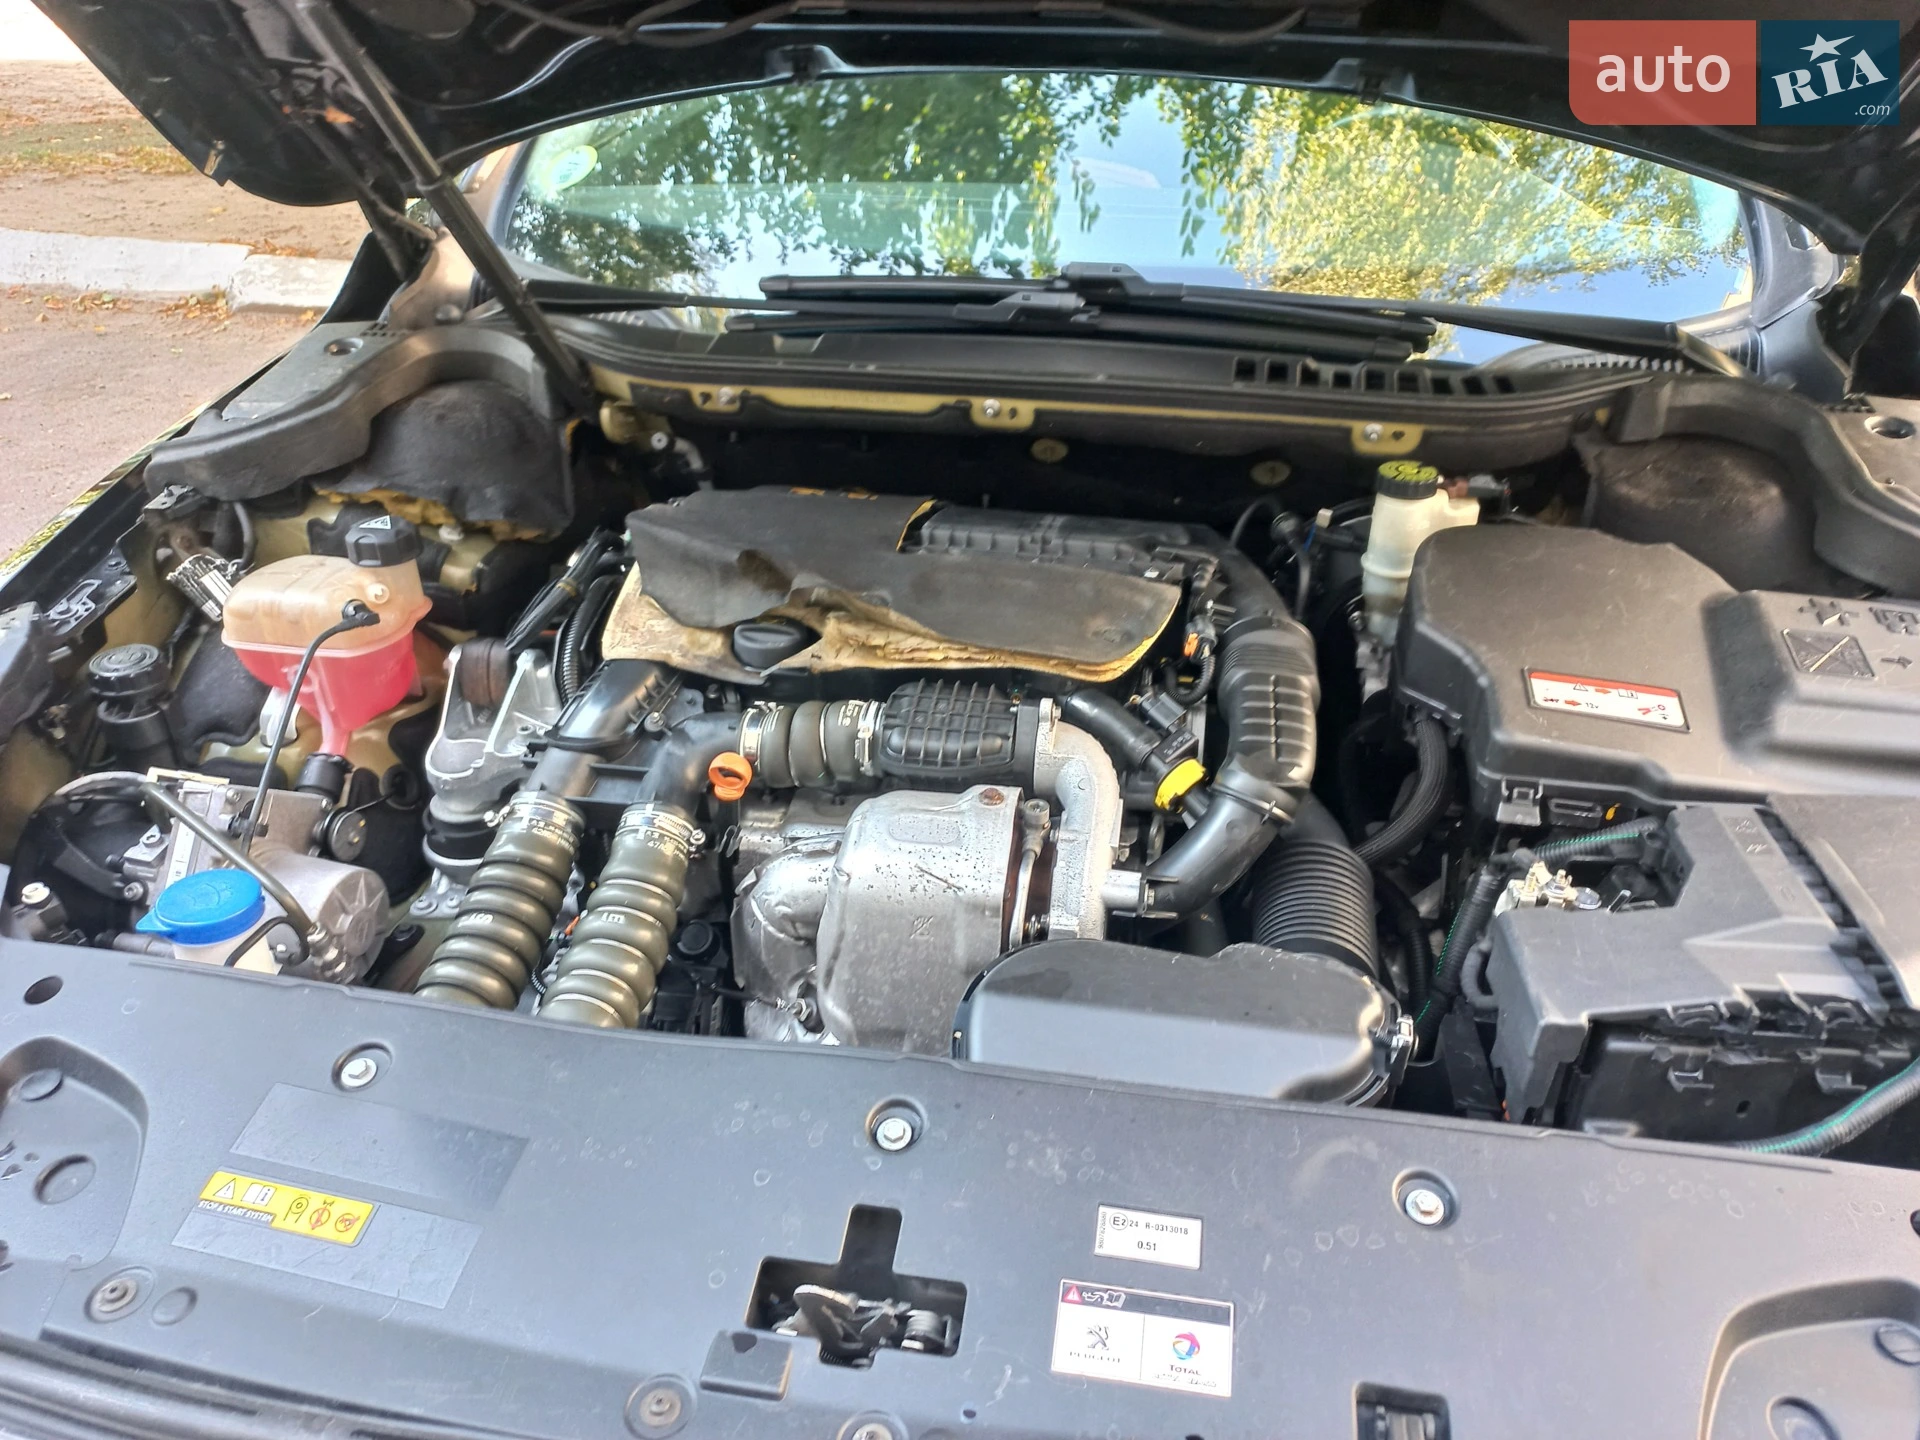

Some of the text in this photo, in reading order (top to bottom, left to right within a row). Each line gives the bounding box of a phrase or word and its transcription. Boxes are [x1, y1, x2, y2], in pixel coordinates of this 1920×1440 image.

[198, 1200, 218, 1210] STOP
[224, 1205, 246, 1216] START
[246, 1209, 274, 1222] SYSTEM
[1129, 1219, 1139, 1228] 24
[1137, 1240, 1157, 1251] 0.51
